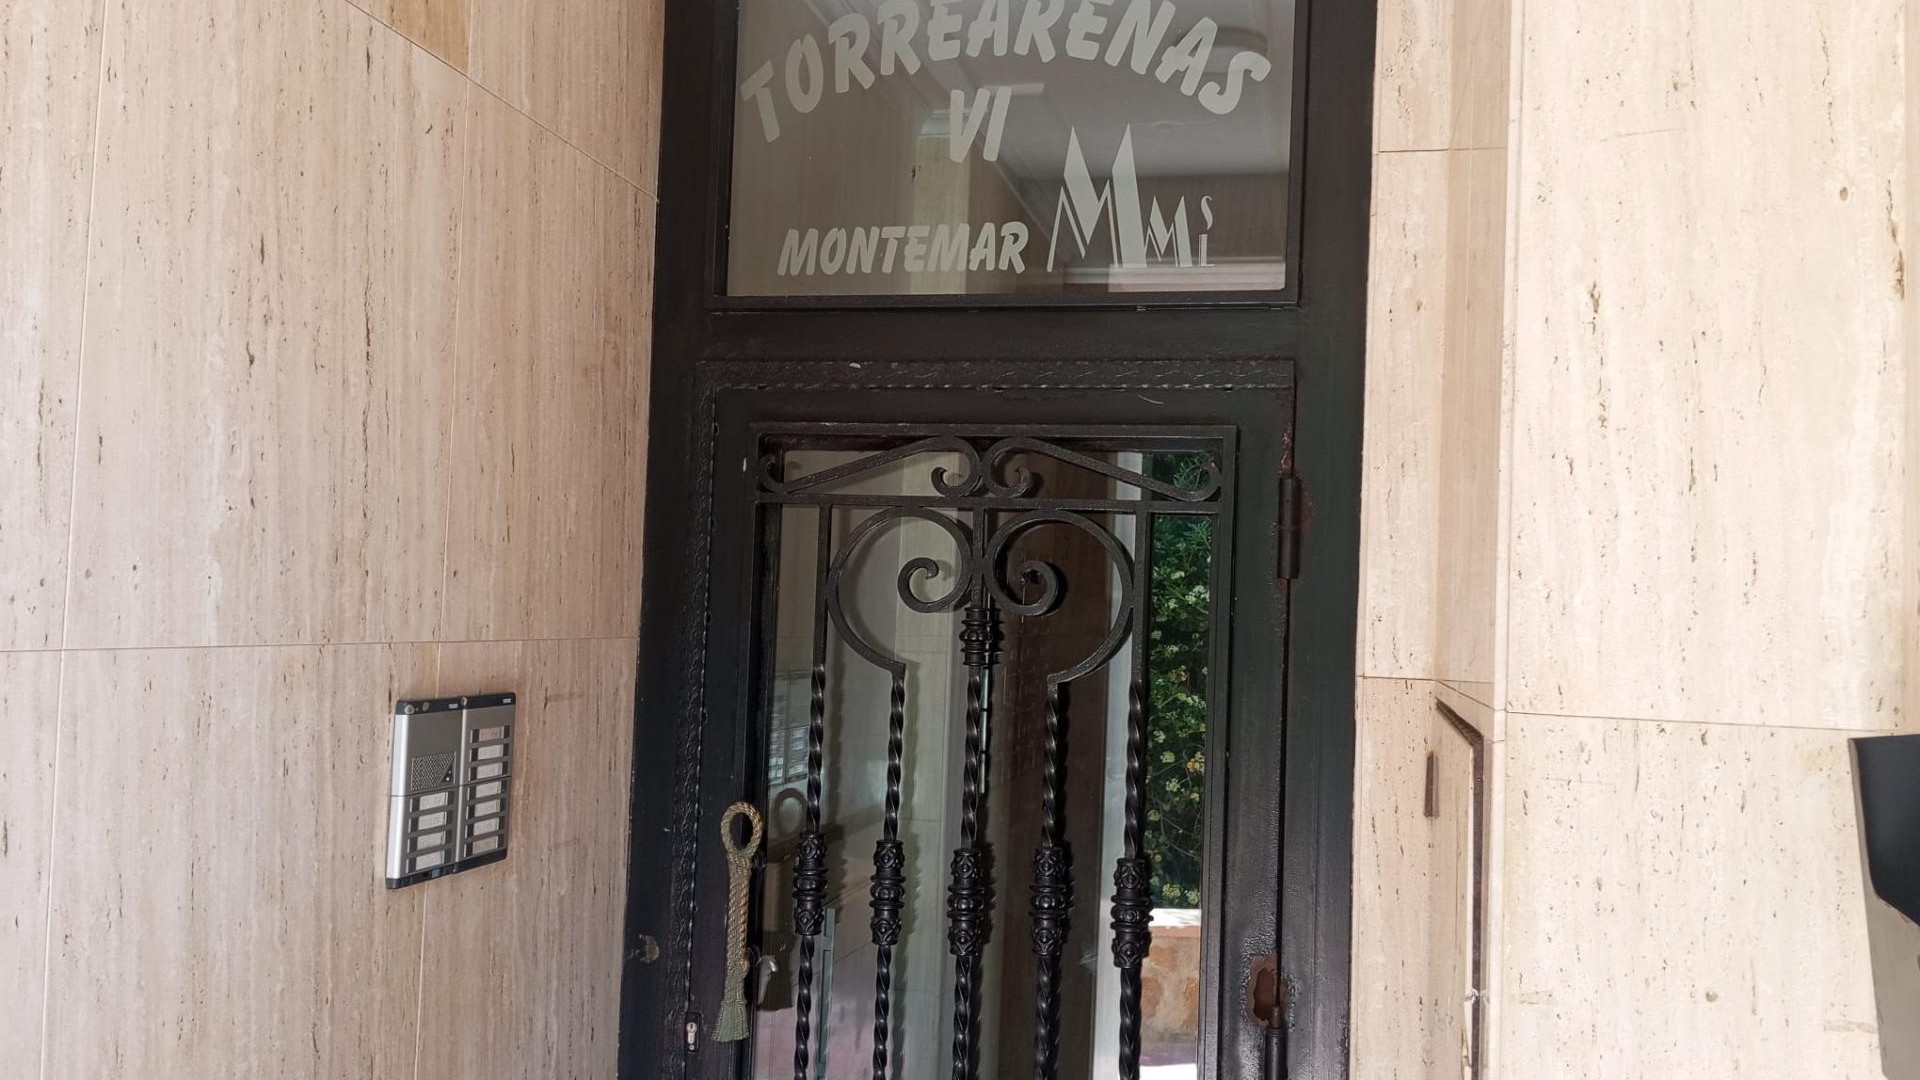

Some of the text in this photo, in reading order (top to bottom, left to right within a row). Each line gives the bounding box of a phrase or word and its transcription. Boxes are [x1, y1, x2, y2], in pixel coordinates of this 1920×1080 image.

[740, 0, 1272, 143] TORREARENAS
[950, 86, 1012, 163] VI
[776, 221, 1029, 276] MONTEMAR
